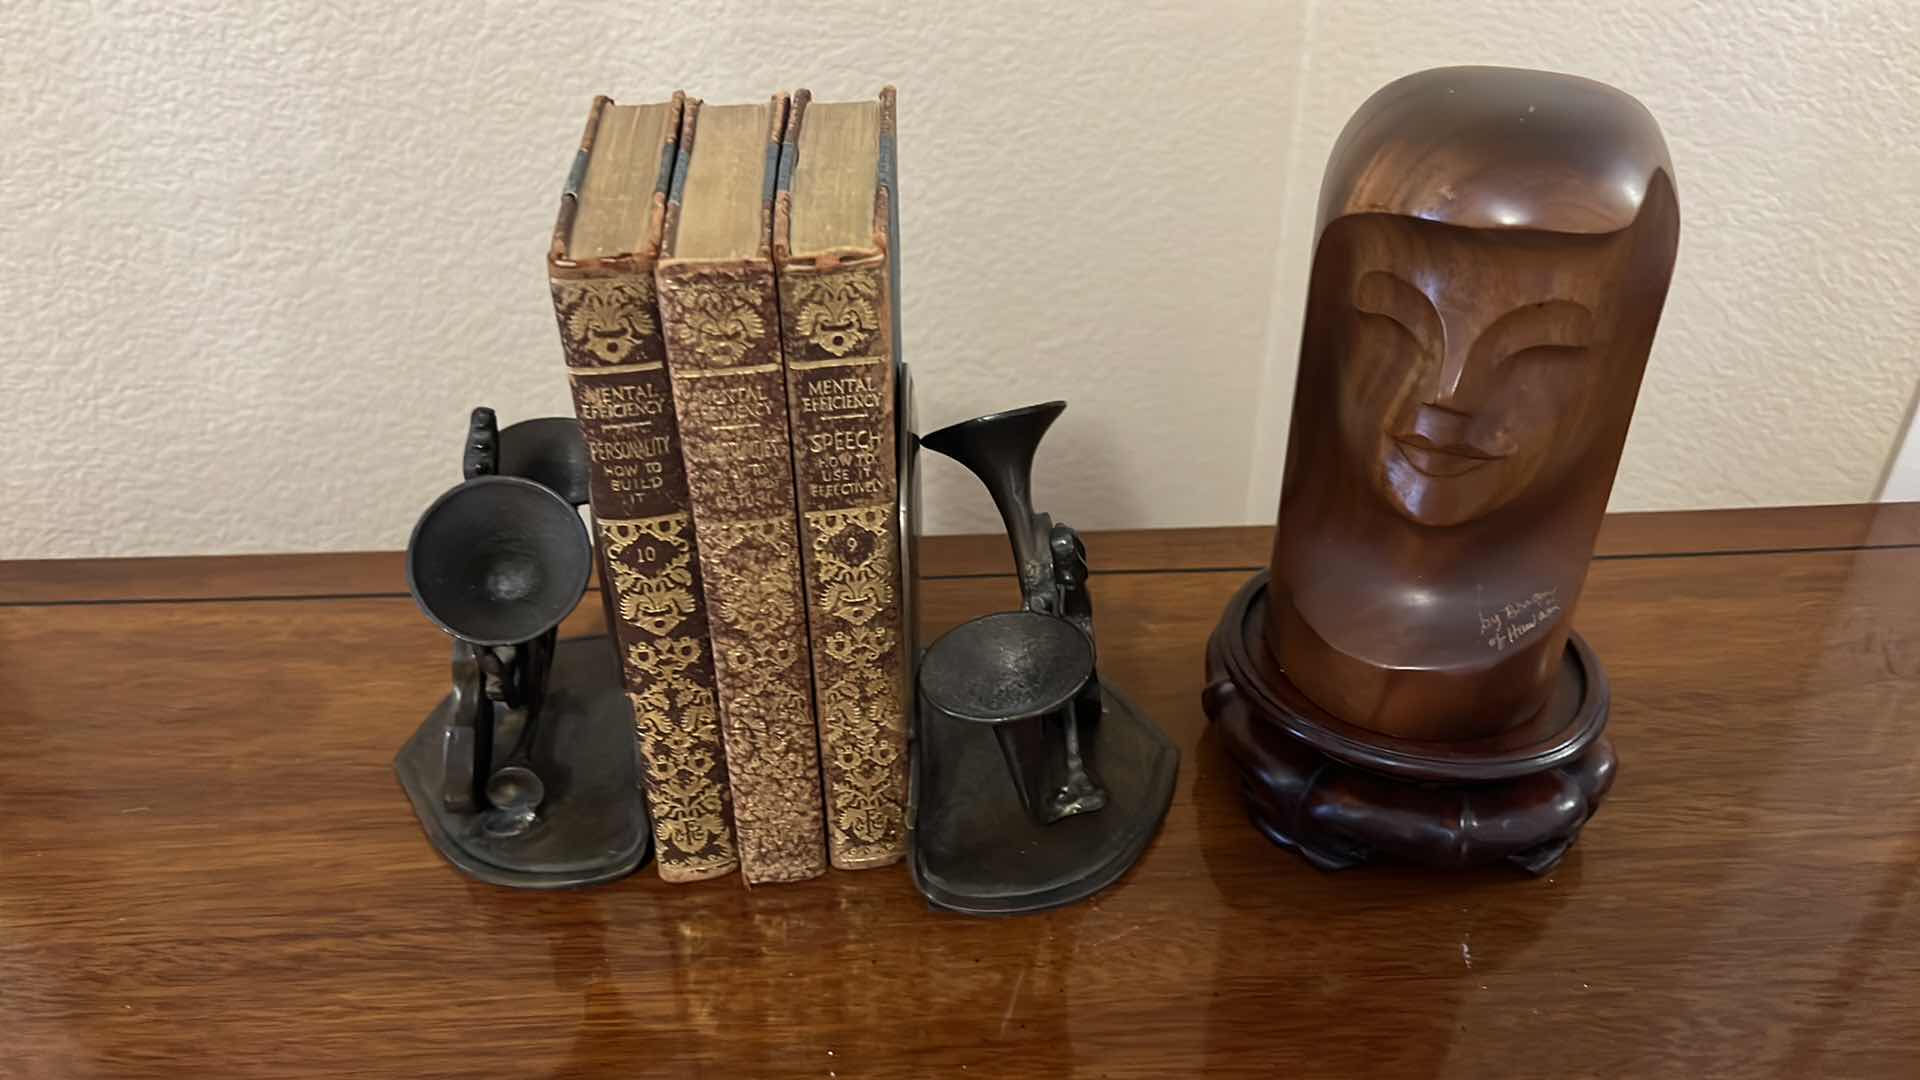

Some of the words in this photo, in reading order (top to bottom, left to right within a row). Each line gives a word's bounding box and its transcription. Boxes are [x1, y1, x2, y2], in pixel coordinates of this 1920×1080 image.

[808, 377, 876, 396] MENTAL
[582, 398, 664, 419] EFFICIENCY
[802, 392, 882, 413] EFFICIENCY
[590, 436, 670, 462] PERSONALITY
[808, 429, 881, 453] SPEECH
[604, 464, 638, 476] HOW
[645, 461, 662, 473] TO
[819, 454, 852, 467] HOW
[855, 453, 875, 466] TO
[821, 469, 849, 482] USE
[858, 467, 872, 480] IT
[610, 476, 663, 492] BUILD
[810, 480, 884, 498] EFFECTIVELY
[847, 537, 858, 552] 9
[637, 546, 656, 563] 10
